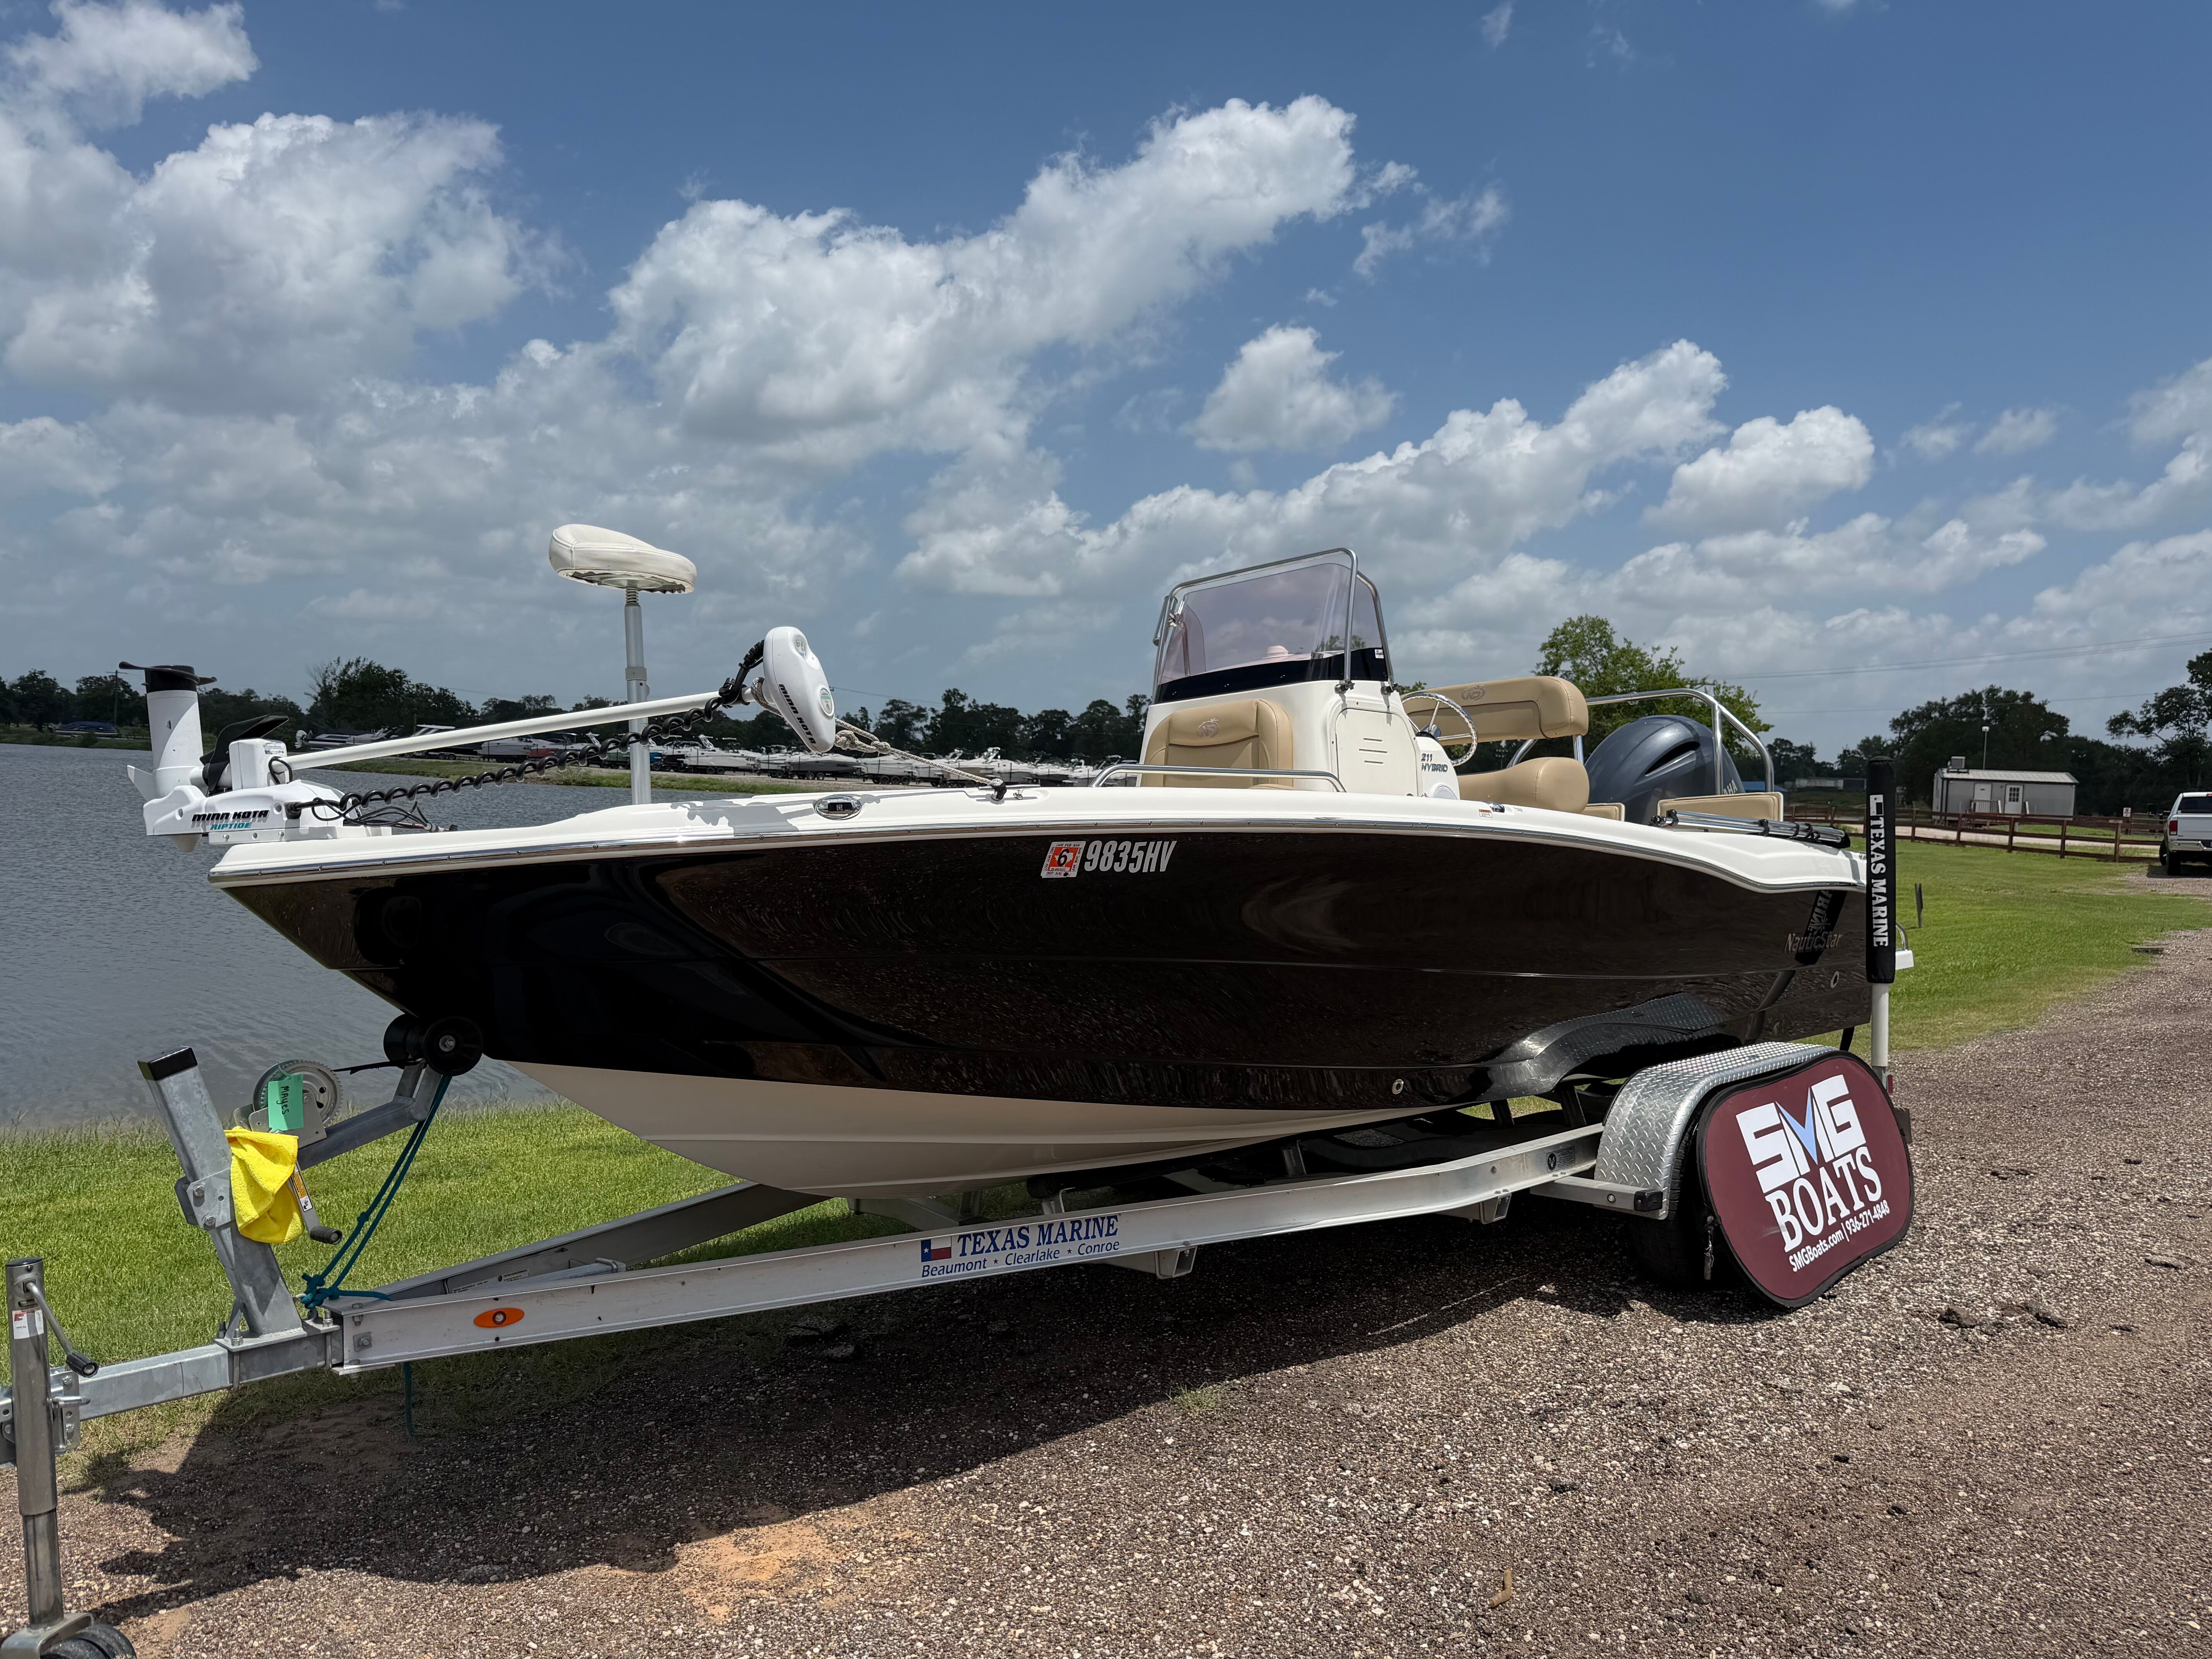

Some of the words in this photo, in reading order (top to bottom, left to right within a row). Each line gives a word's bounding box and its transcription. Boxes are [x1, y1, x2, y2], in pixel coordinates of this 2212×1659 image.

[778, 684, 799, 714] MINN
[797, 717, 816, 744] KOTA
[1421, 753, 1433, 762] 211
[1421, 763, 1448, 773] HYBRID
[191, 812, 230, 822] MINN
[232, 810, 270, 819] KOTA
[210, 822, 253, 830] RIPTIDE
[1057, 848, 1070, 867] 6
[1084, 840, 1177, 873] 9835HV
[1870, 817, 1886, 874] TEXAS
[1871, 878, 1889, 947] MARINE
[1784, 931, 1843, 953] NauticStar
[1735, 1074, 1866, 1194] SMG
[1764, 1146, 1882, 1253] BOATS
[957, 1226, 1030, 1257] TEXAS
[1036, 1215, 1119, 1247] MARINE
[1789, 1229, 1844, 1273] SMGBoats.com
[1845, 1199, 1890, 1235] 936-271-4848
[921, 1257, 988, 1278] Beaumont
[1005, 1248, 1060, 1266] Clearlake
[1077, 1241, 1120, 1256] Conroe
